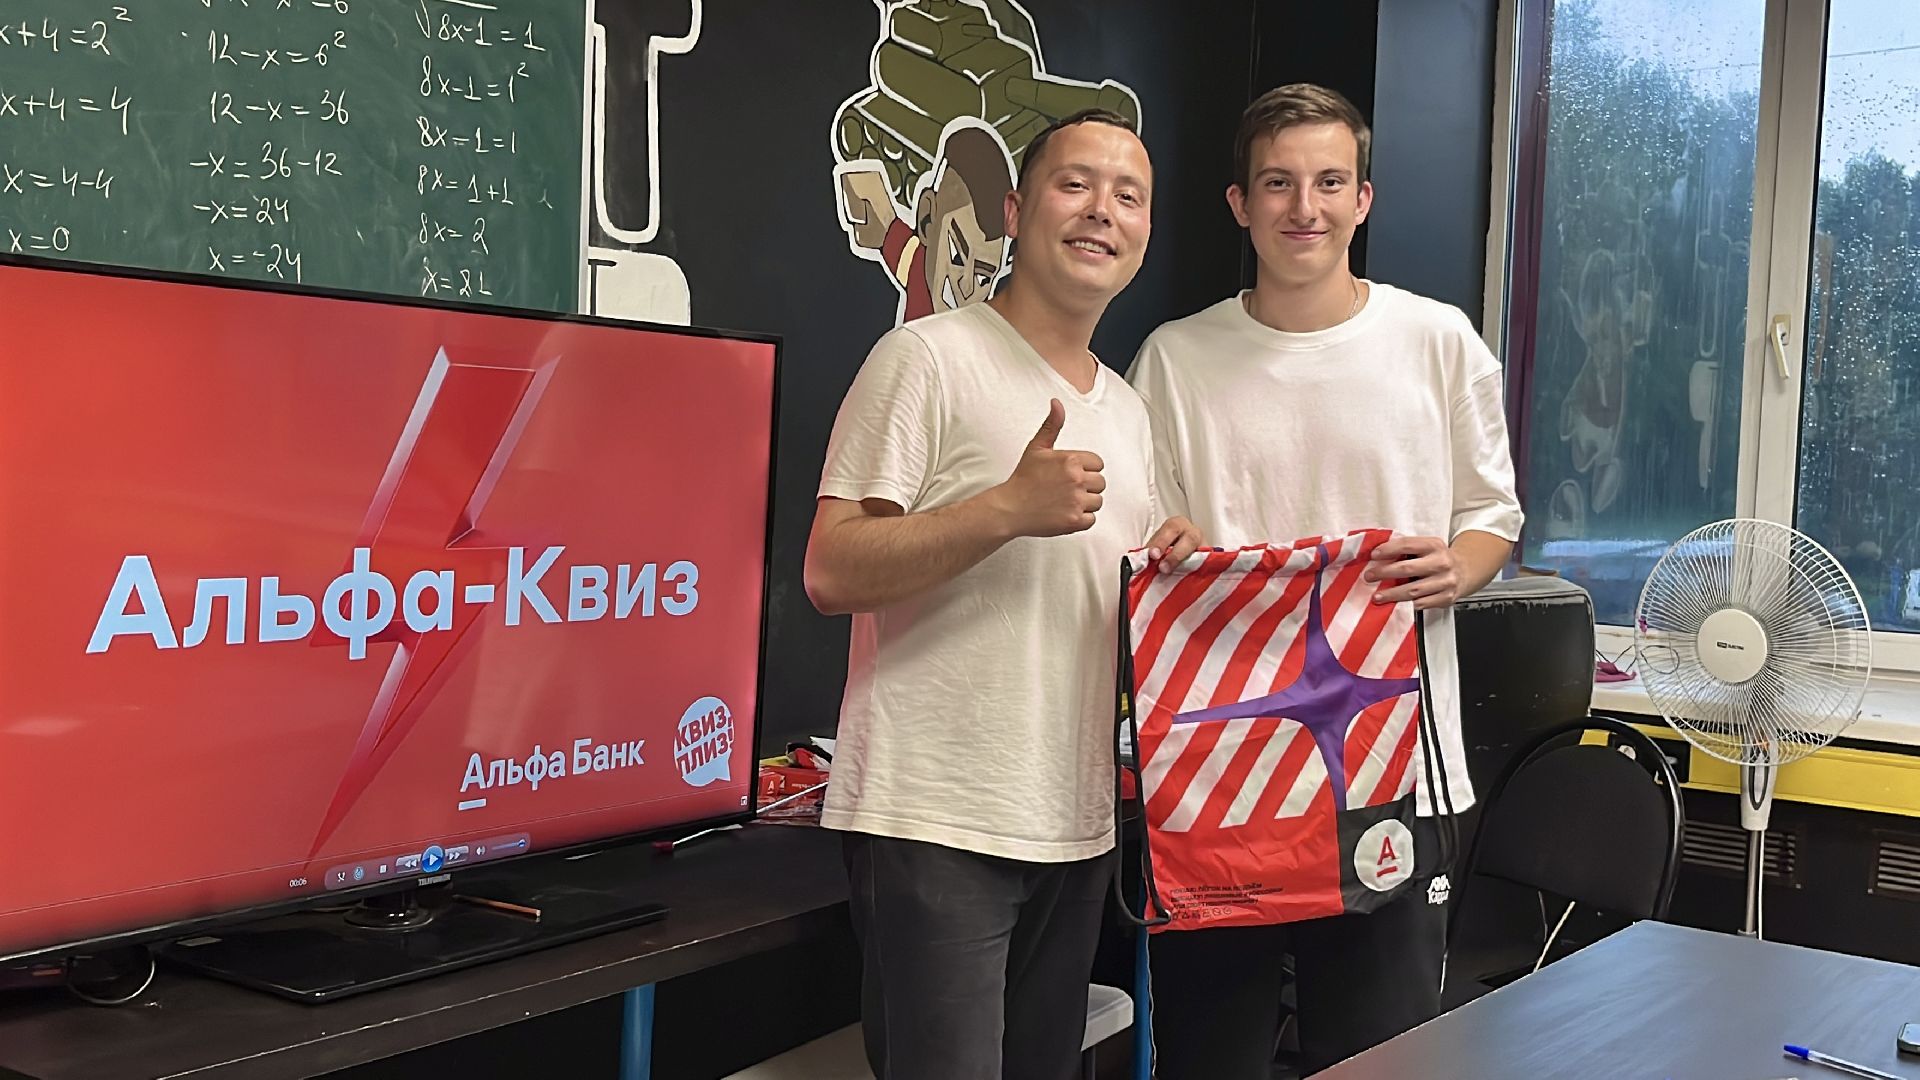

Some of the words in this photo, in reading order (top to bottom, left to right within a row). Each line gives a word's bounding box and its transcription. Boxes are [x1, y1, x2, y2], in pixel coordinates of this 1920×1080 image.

[86, 545, 700, 660] Альфа-Квиз
[459, 744, 566, 791] Альфа
[572, 737, 646, 776] Банк
[289, 878, 308, 888] 00:06
